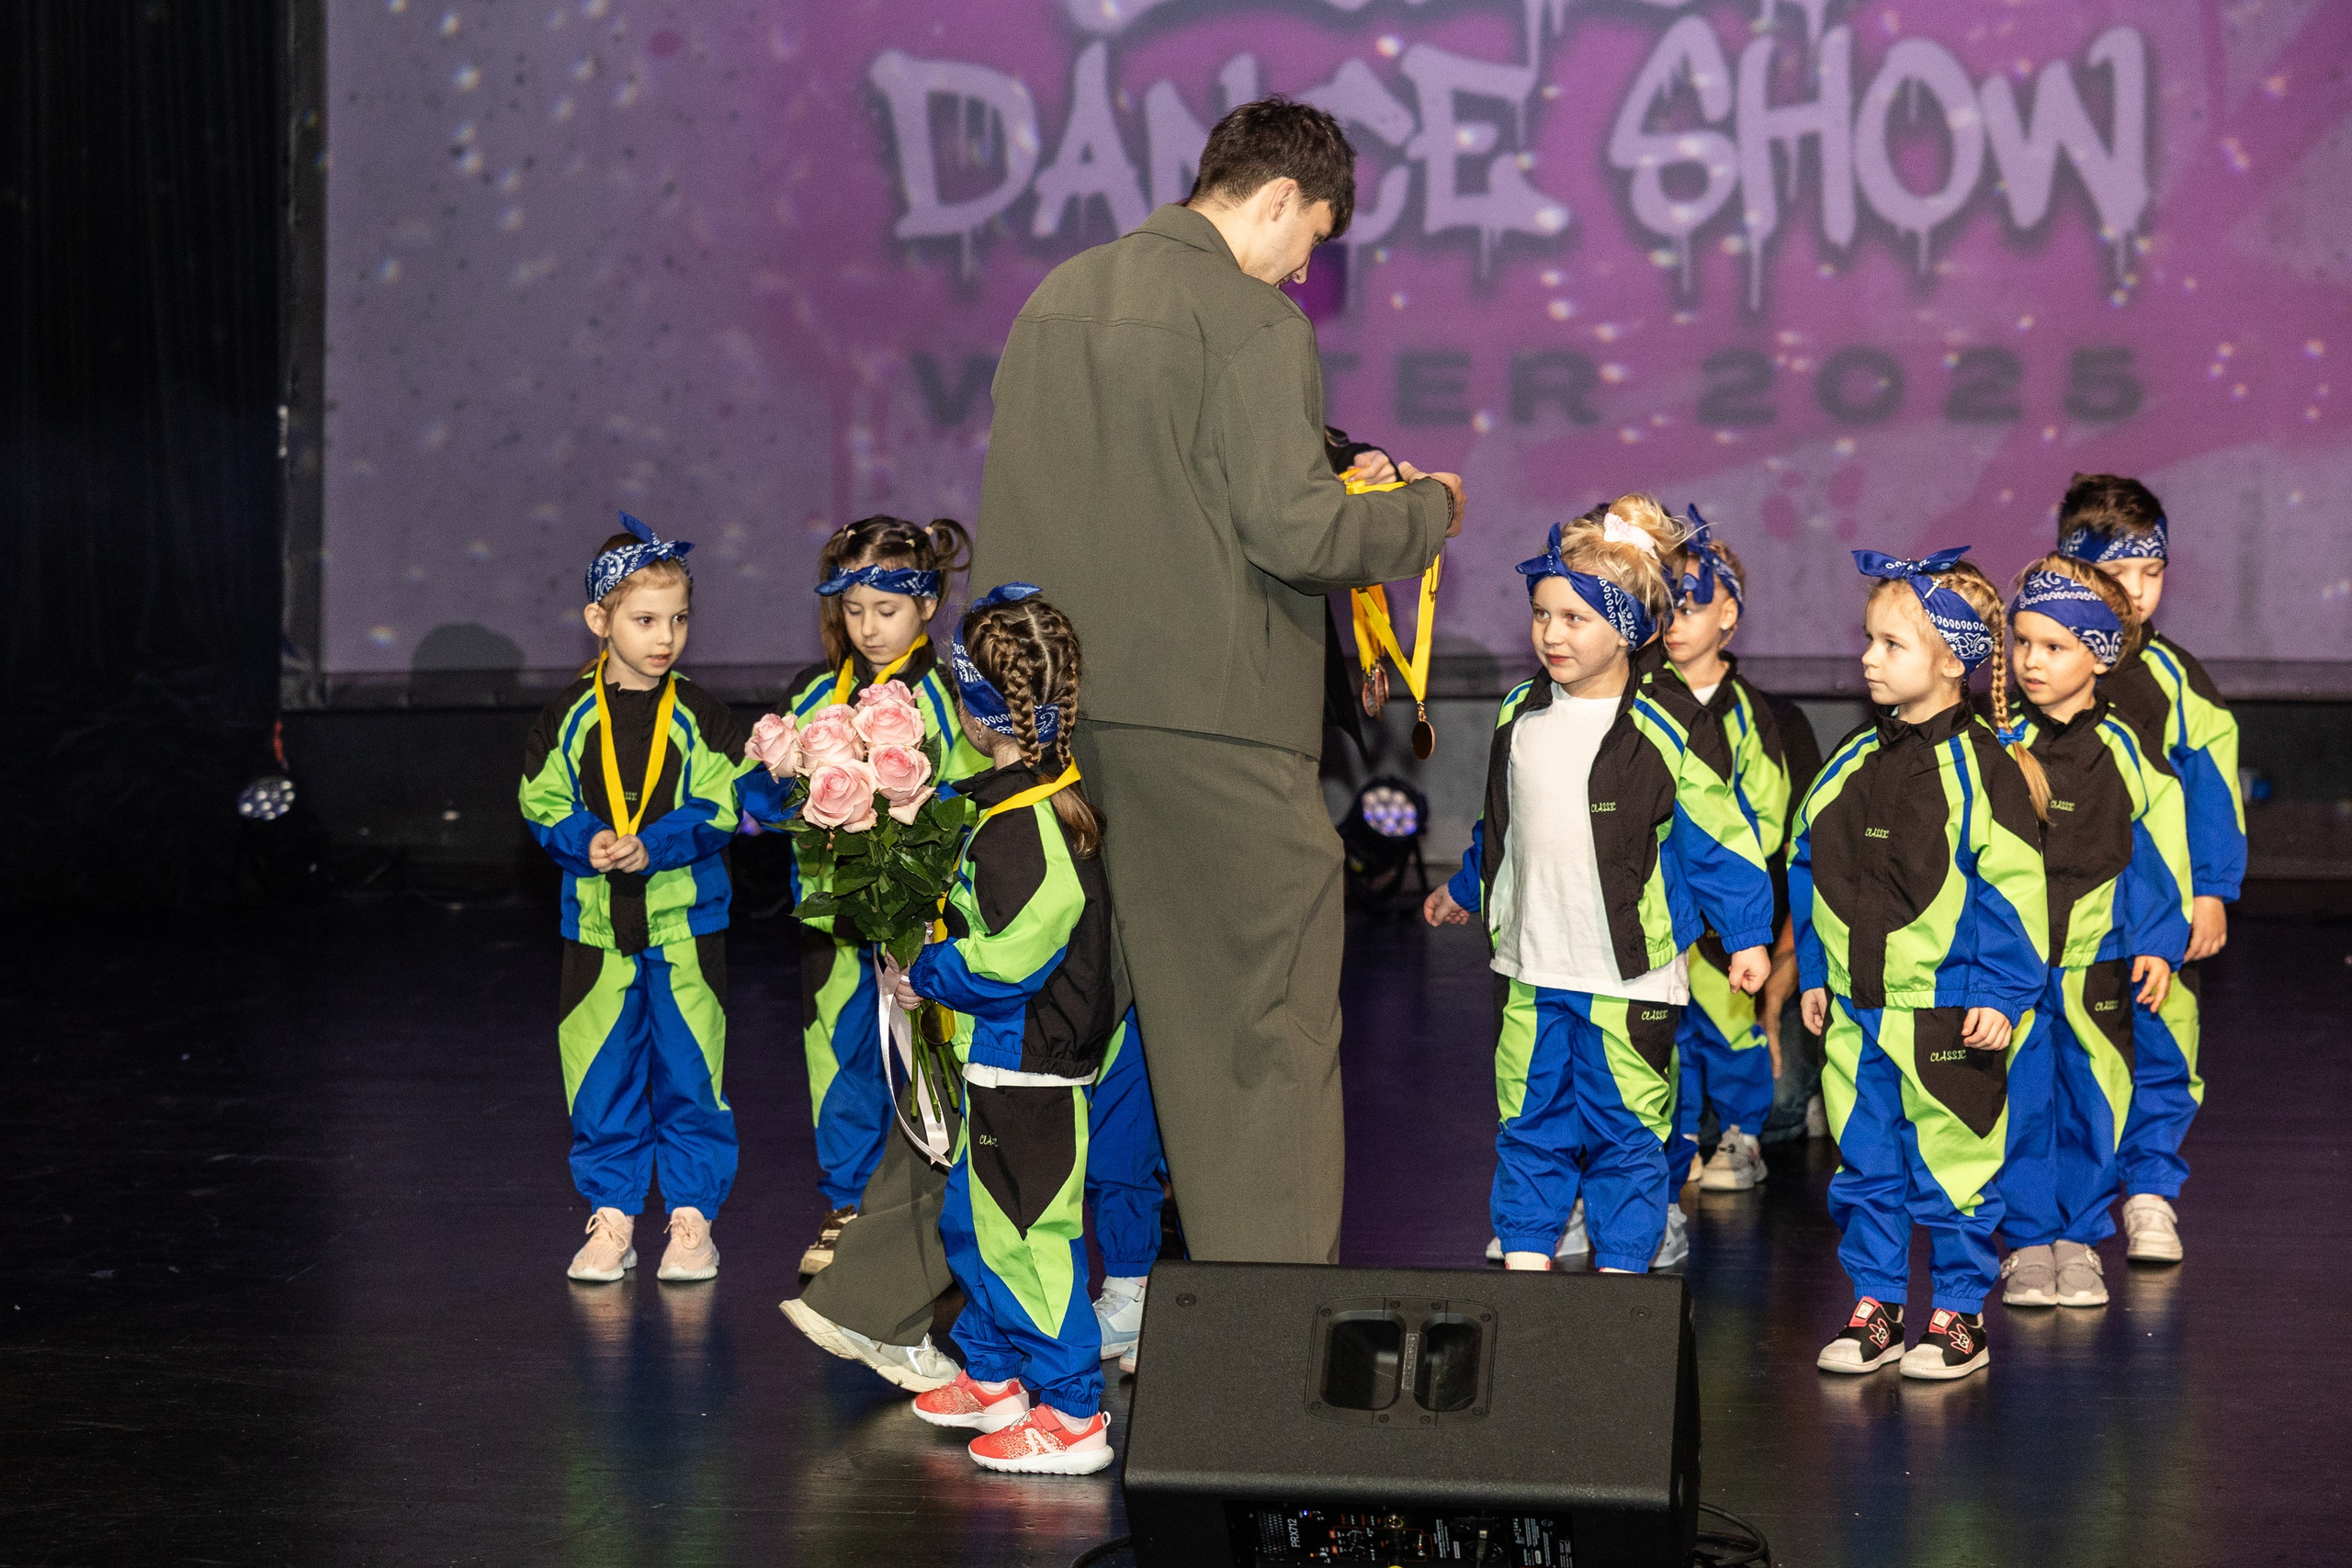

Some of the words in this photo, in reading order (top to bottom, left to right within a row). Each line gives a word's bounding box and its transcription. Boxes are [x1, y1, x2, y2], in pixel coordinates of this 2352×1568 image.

[1608, 15, 2149, 250] SHOW
[1697, 347, 2144, 427] 2025
[1929, 1049, 1966, 1062] CLASSIC
[1287, 1517, 1301, 1549] PRX712
